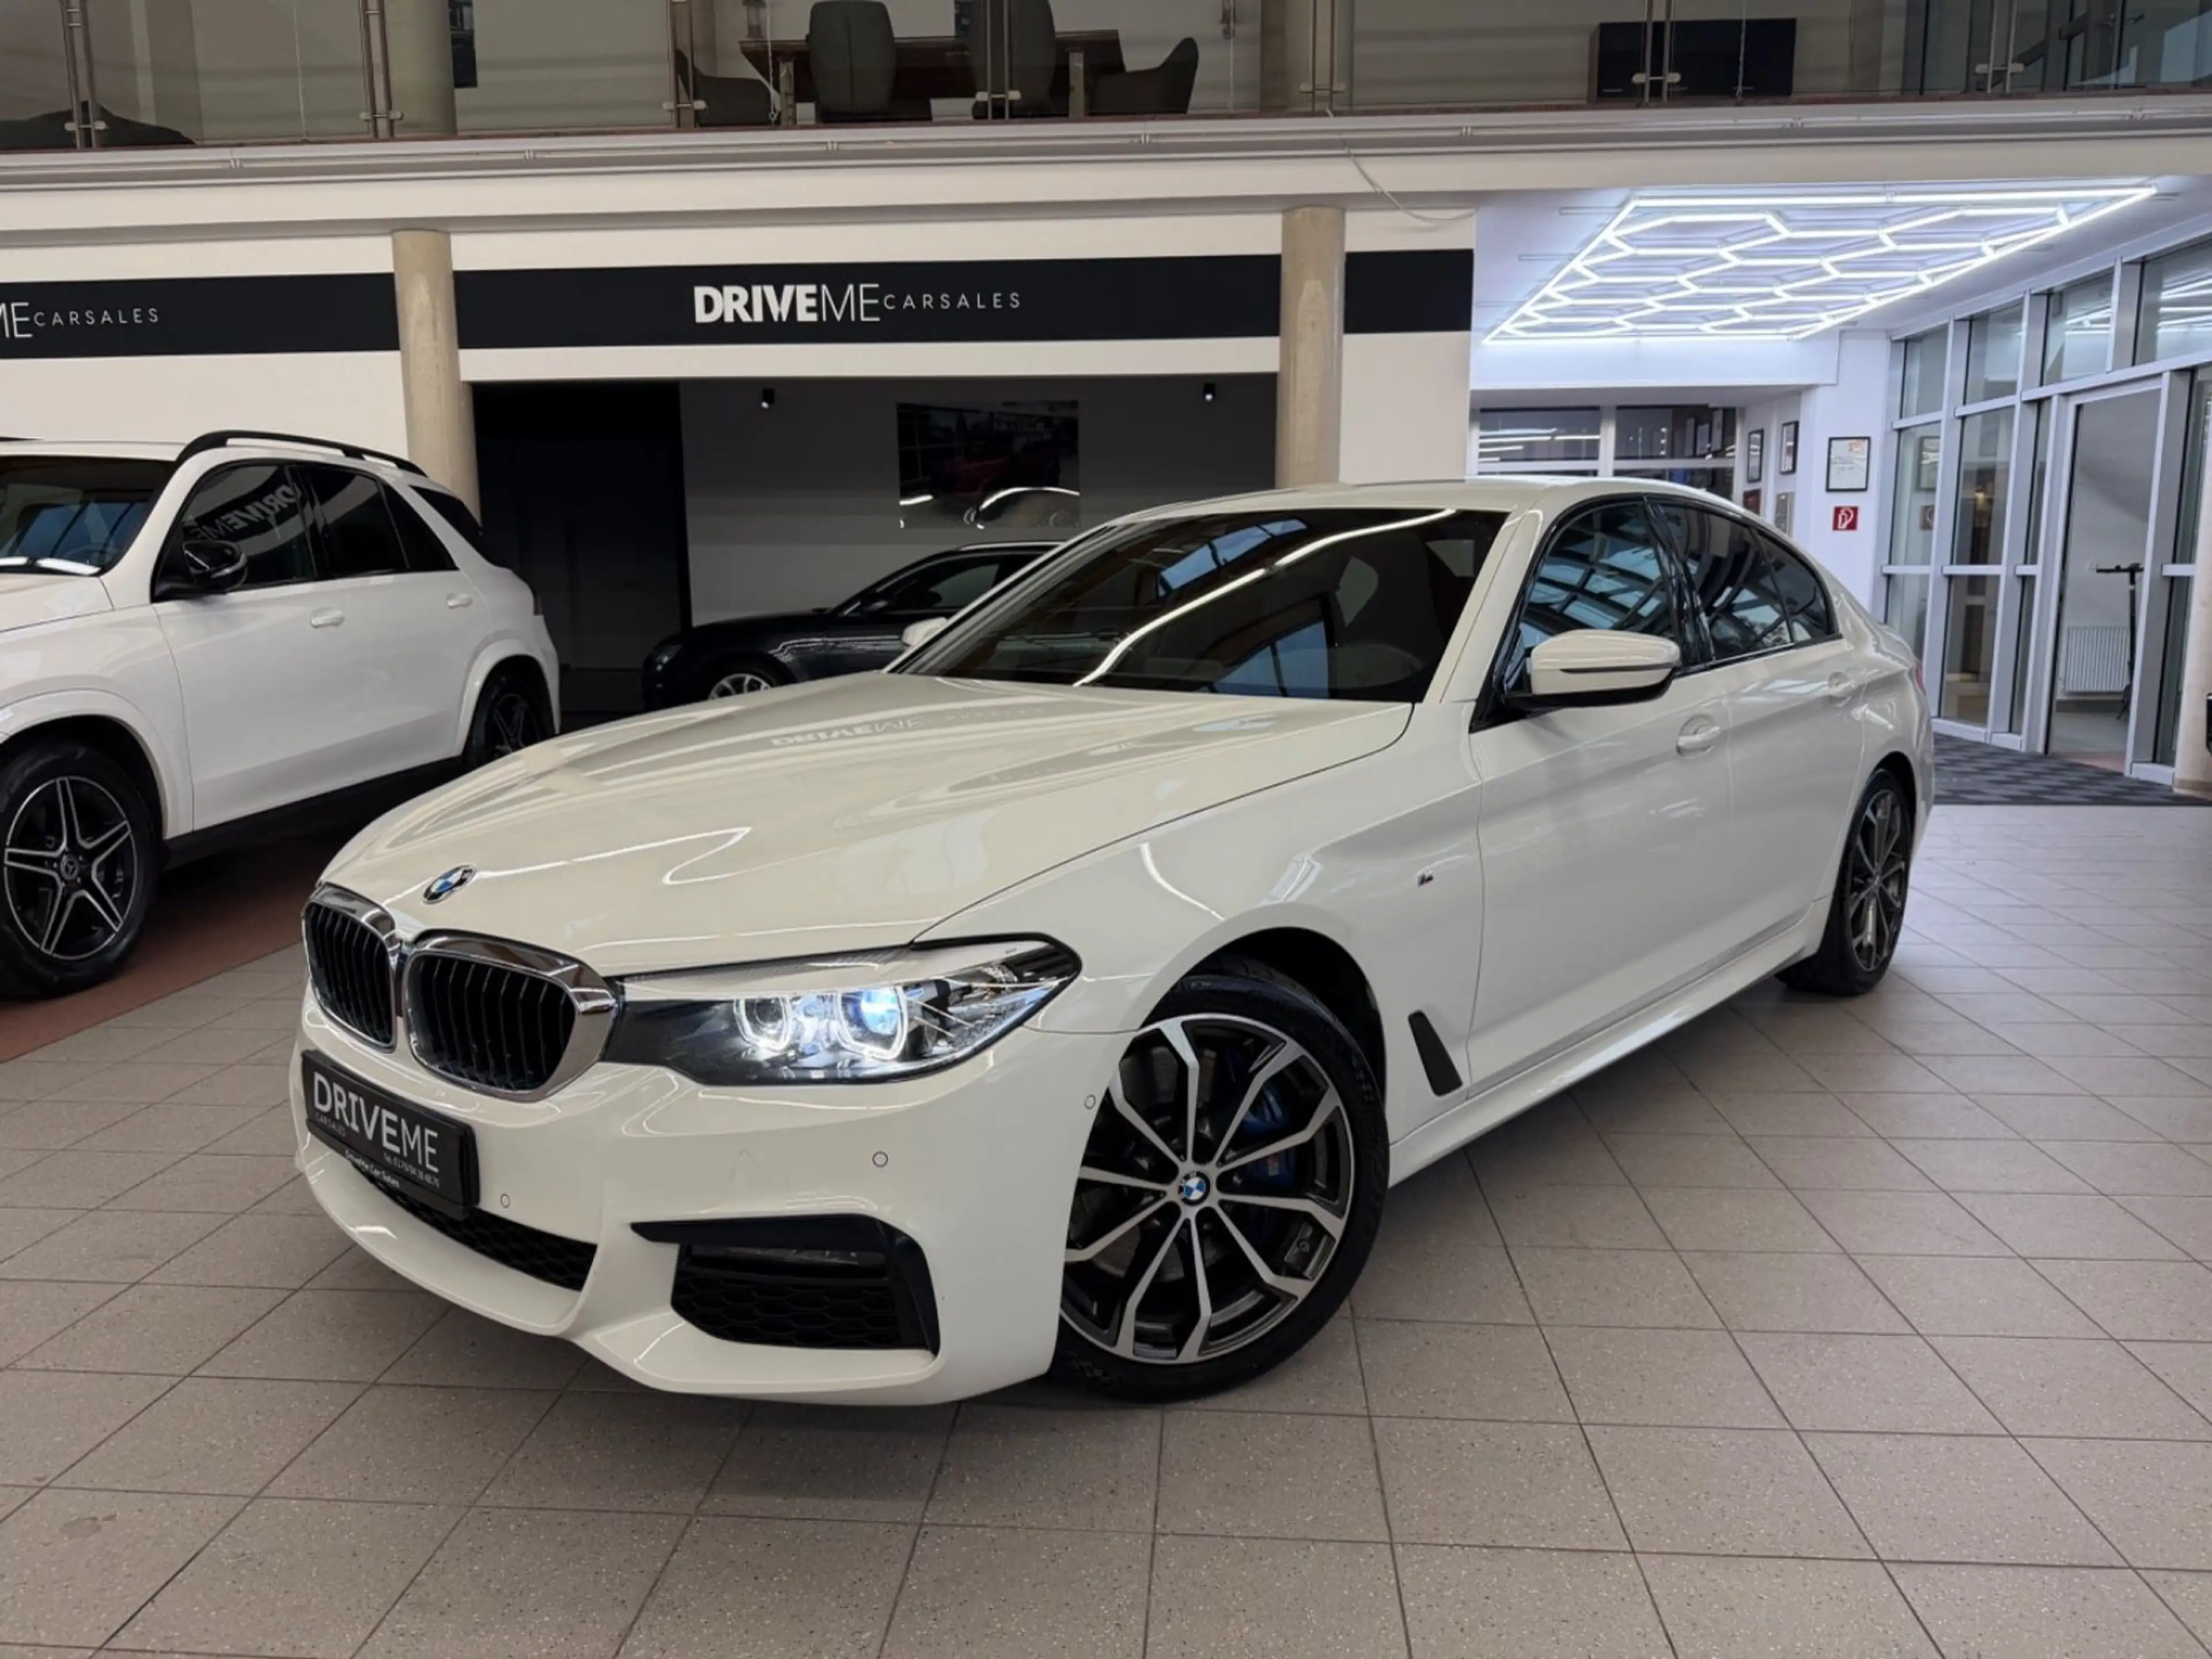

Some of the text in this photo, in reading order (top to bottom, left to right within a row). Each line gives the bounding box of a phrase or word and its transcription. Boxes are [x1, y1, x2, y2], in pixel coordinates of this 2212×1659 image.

[33, 308, 158, 327] CARSALES
[693, 283, 1020, 323] DRIVEME CARSALES
[313, 1071, 440, 1173] DRIVEME
